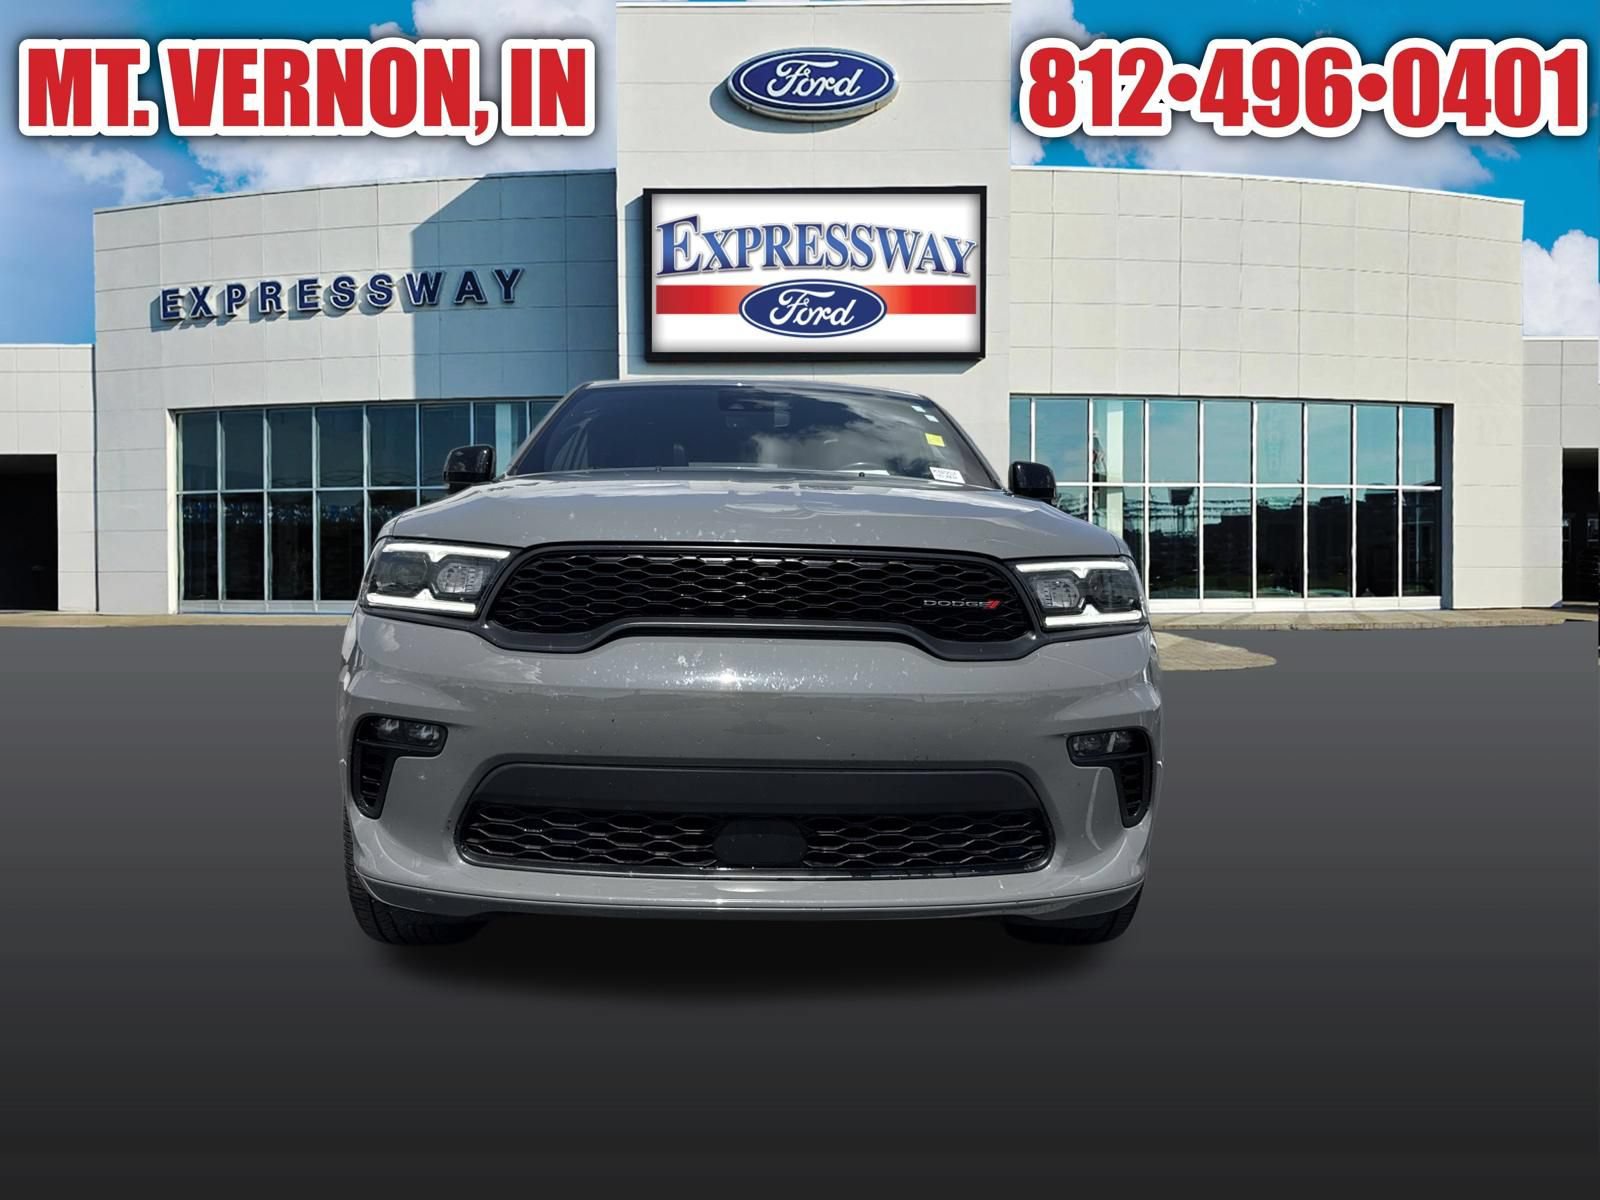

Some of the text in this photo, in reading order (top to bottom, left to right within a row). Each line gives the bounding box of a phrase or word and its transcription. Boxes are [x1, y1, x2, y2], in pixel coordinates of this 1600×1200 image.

[766, 59, 864, 97] Ford
[159, 268, 525, 322] EXPRESSWAY
[768, 288, 857, 326] Ford
[923, 599, 988, 608] DODGE
